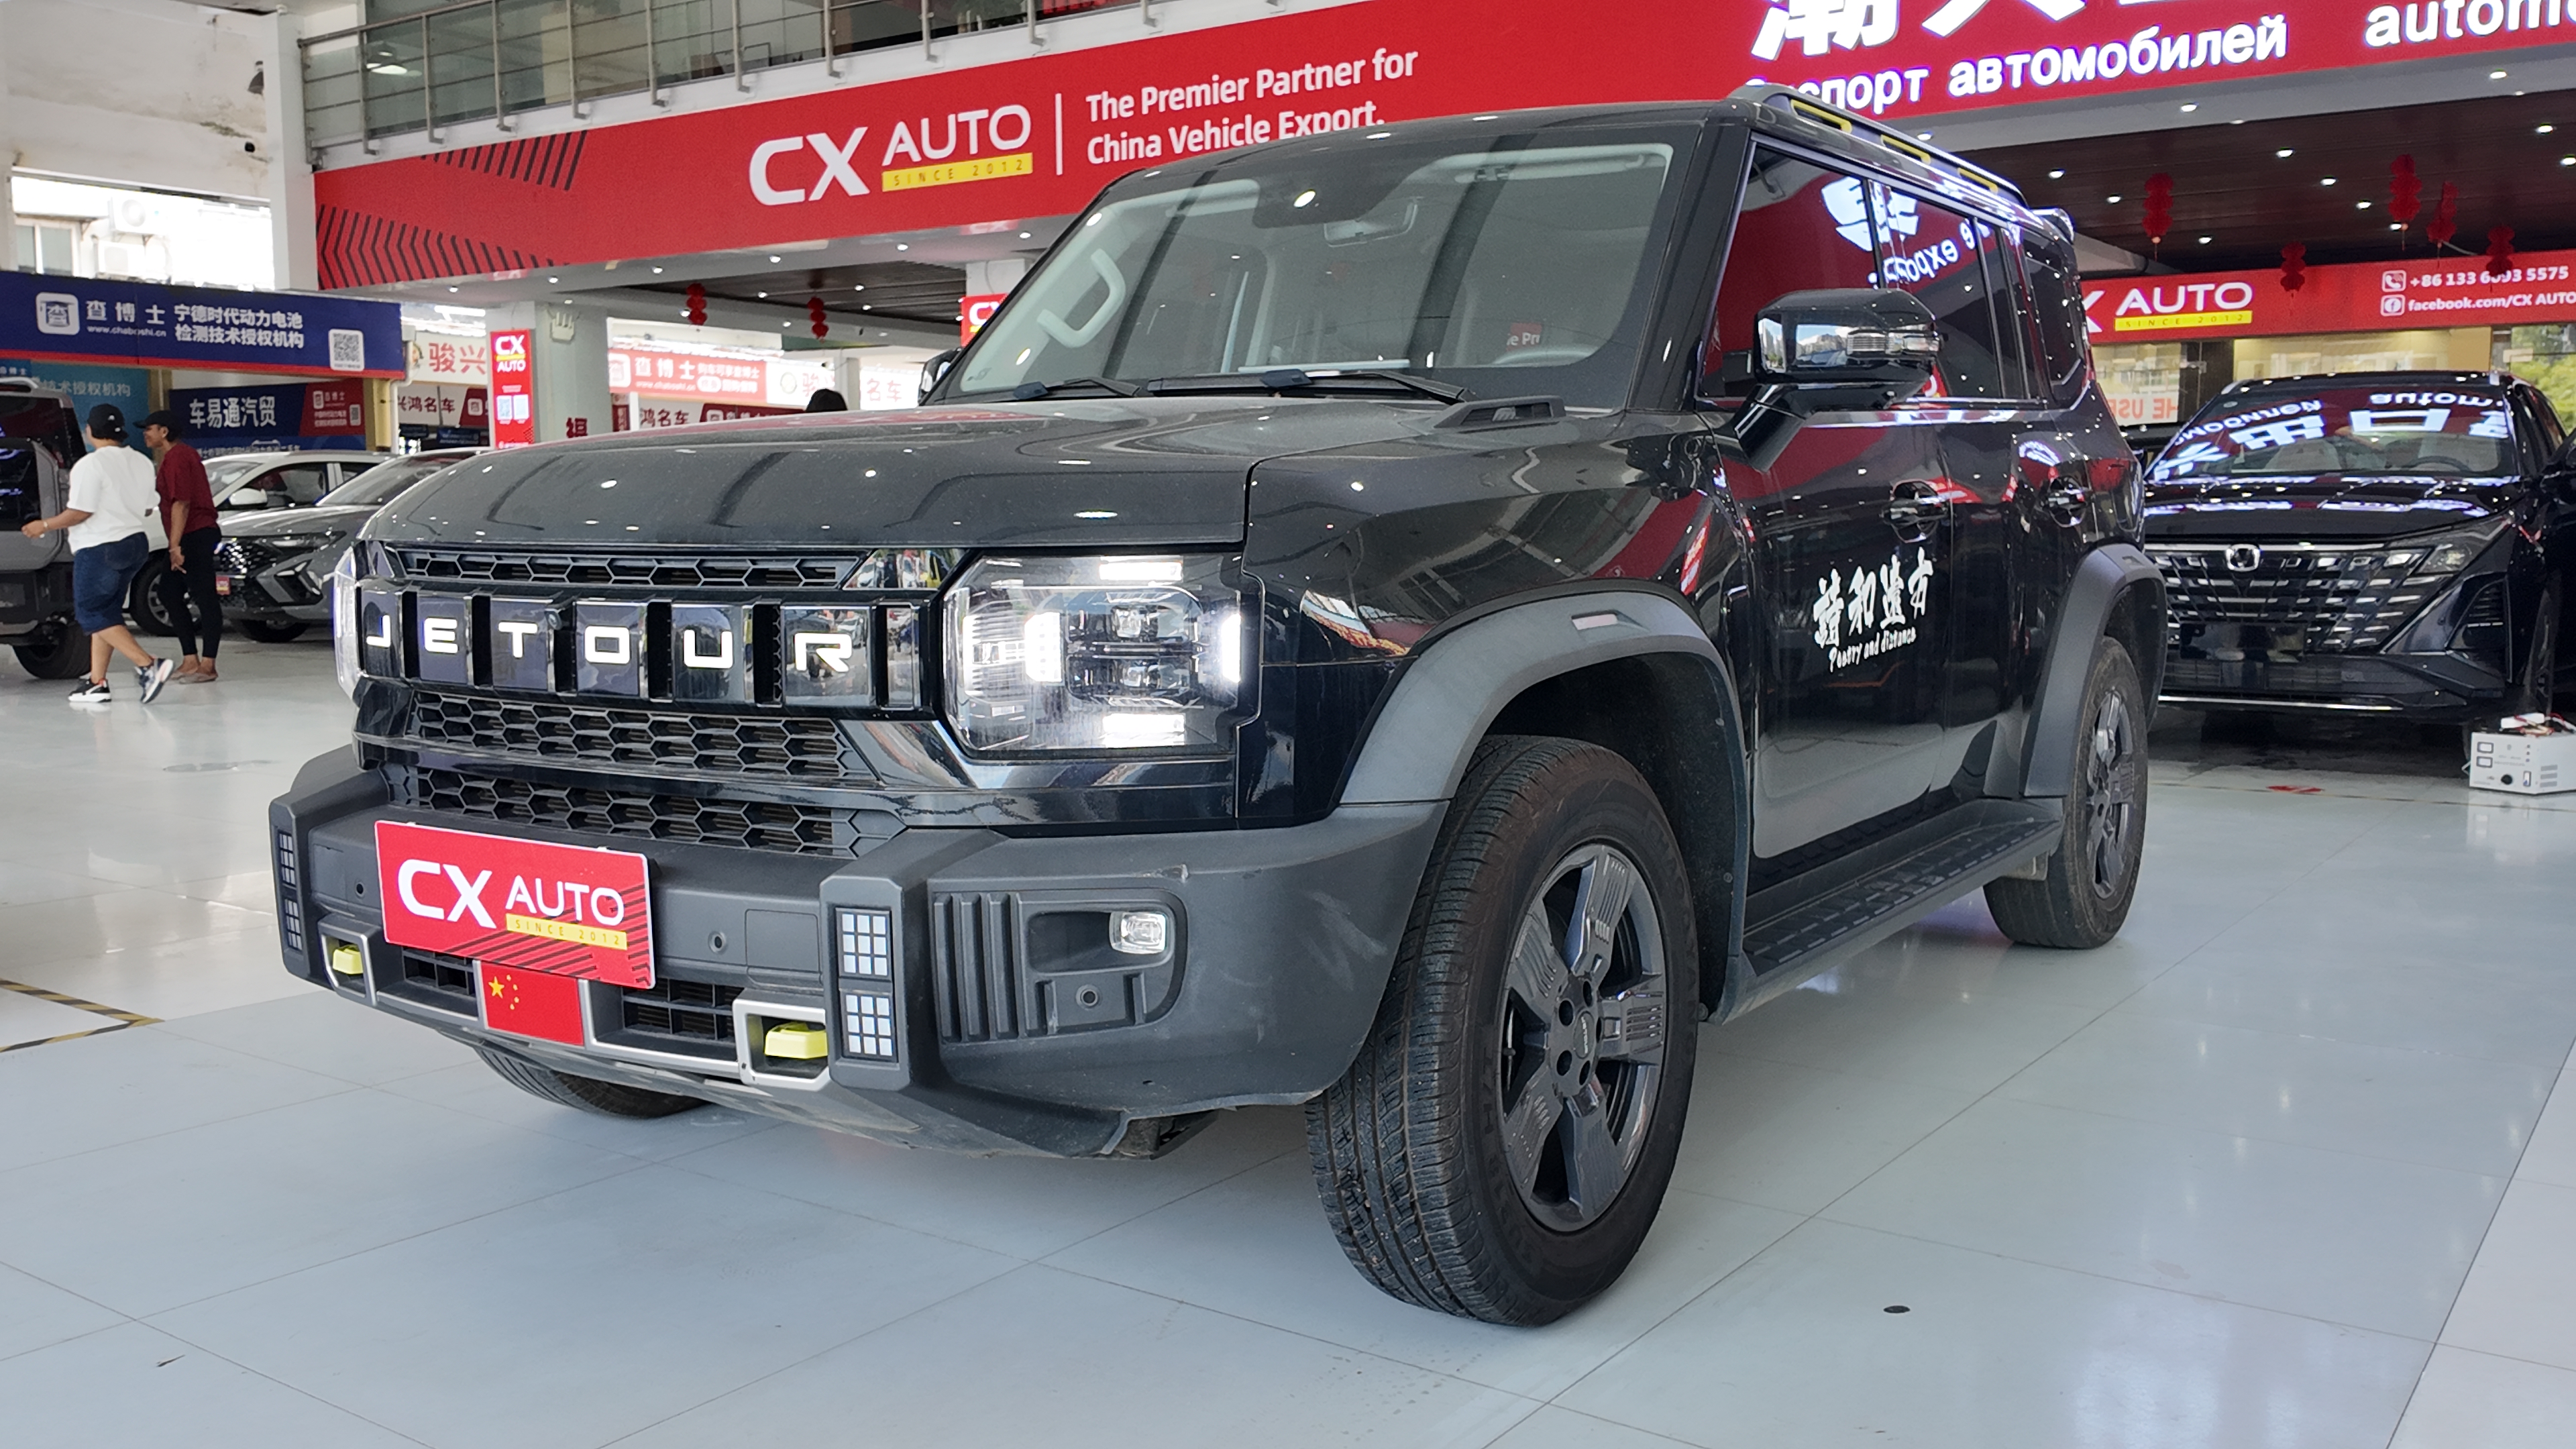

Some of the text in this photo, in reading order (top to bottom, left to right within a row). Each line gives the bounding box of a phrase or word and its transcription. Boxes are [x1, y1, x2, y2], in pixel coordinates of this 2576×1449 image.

[1745, 68, 1929, 115] порт
[1947, 14, 2288, 97] автомобилей
[1086, 48, 1418, 122] The Premier Partner for
[1087, 101, 1385, 164] China Vehicle Export.
[749, 105, 1031, 206] CX AUTO
[894, 159, 1024, 186] SINCE 2012
[2410, 273, 2443, 288] +86
[2445, 272, 2477, 286] 133
[2526, 266, 2569, 282] 5575
[969, 301, 1001, 326] C
[2115, 282, 2253, 317] AUTO
[2408, 291, 2576, 311] facebook.com/CX AUTO
[86, 300, 165, 325] 查博士
[174, 304, 303, 329] 宁德时代动力电池
[2125, 313, 2244, 327] SINCE 2012
[174, 323, 305, 349] 检测技术授权机构
[495, 334, 525, 355] CX
[428, 341, 486, 375] 骏兴
[497, 359, 527, 372] AUTO
[189, 395, 277, 429] 车易通汽贸
[366, 614, 853, 672] JETOUR
[1864, 631, 1880, 659] and
[397, 859, 625, 928] CX AUTO
[515, 919, 621, 946] SINCE 2012
